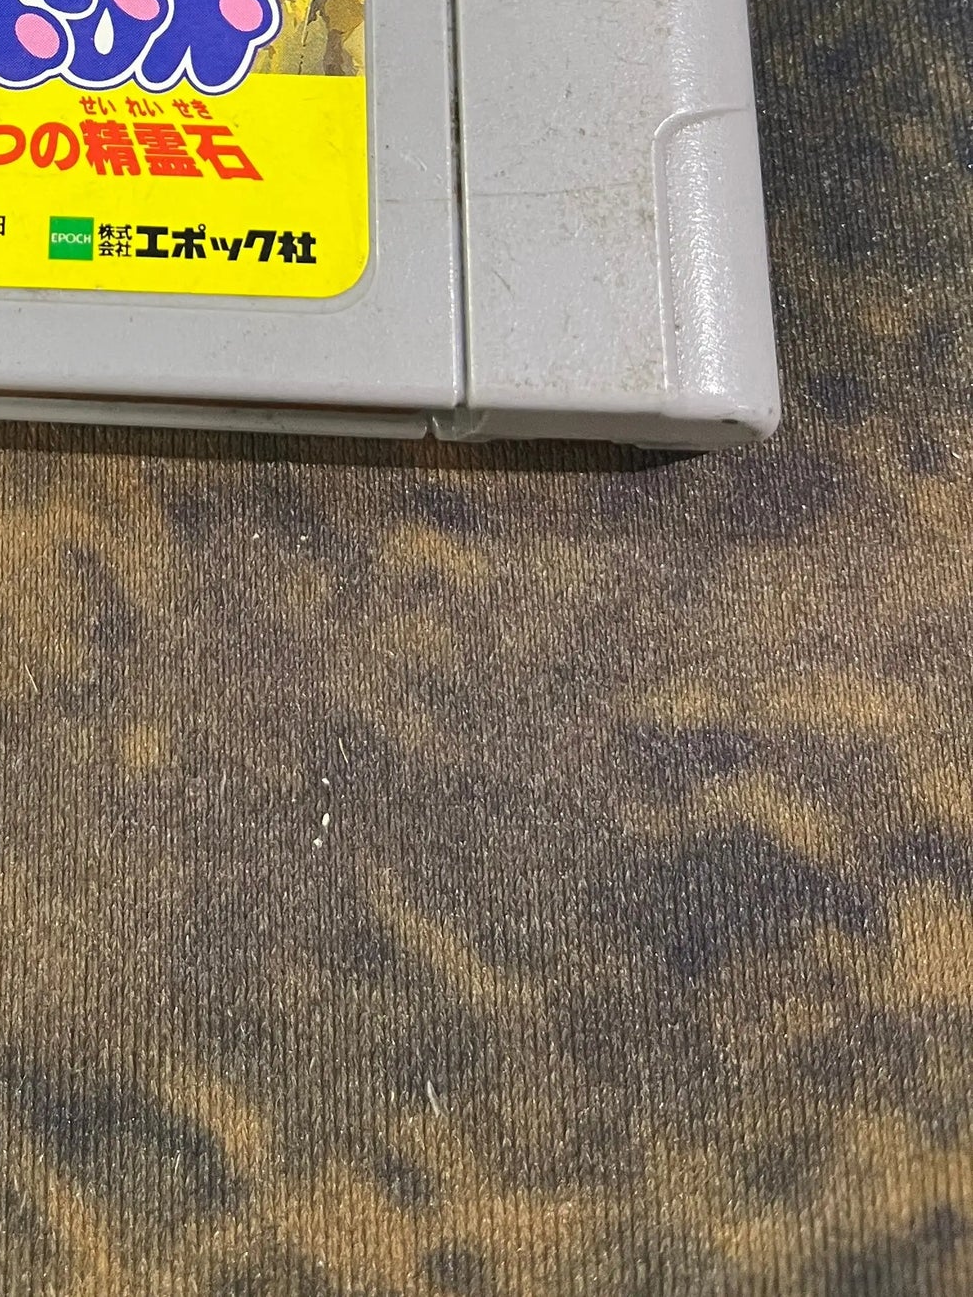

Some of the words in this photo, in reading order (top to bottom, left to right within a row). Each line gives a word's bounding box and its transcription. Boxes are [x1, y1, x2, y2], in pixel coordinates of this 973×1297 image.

[51, 233, 92, 245] EPOCH
[135, 223, 317, 264] エポック社
